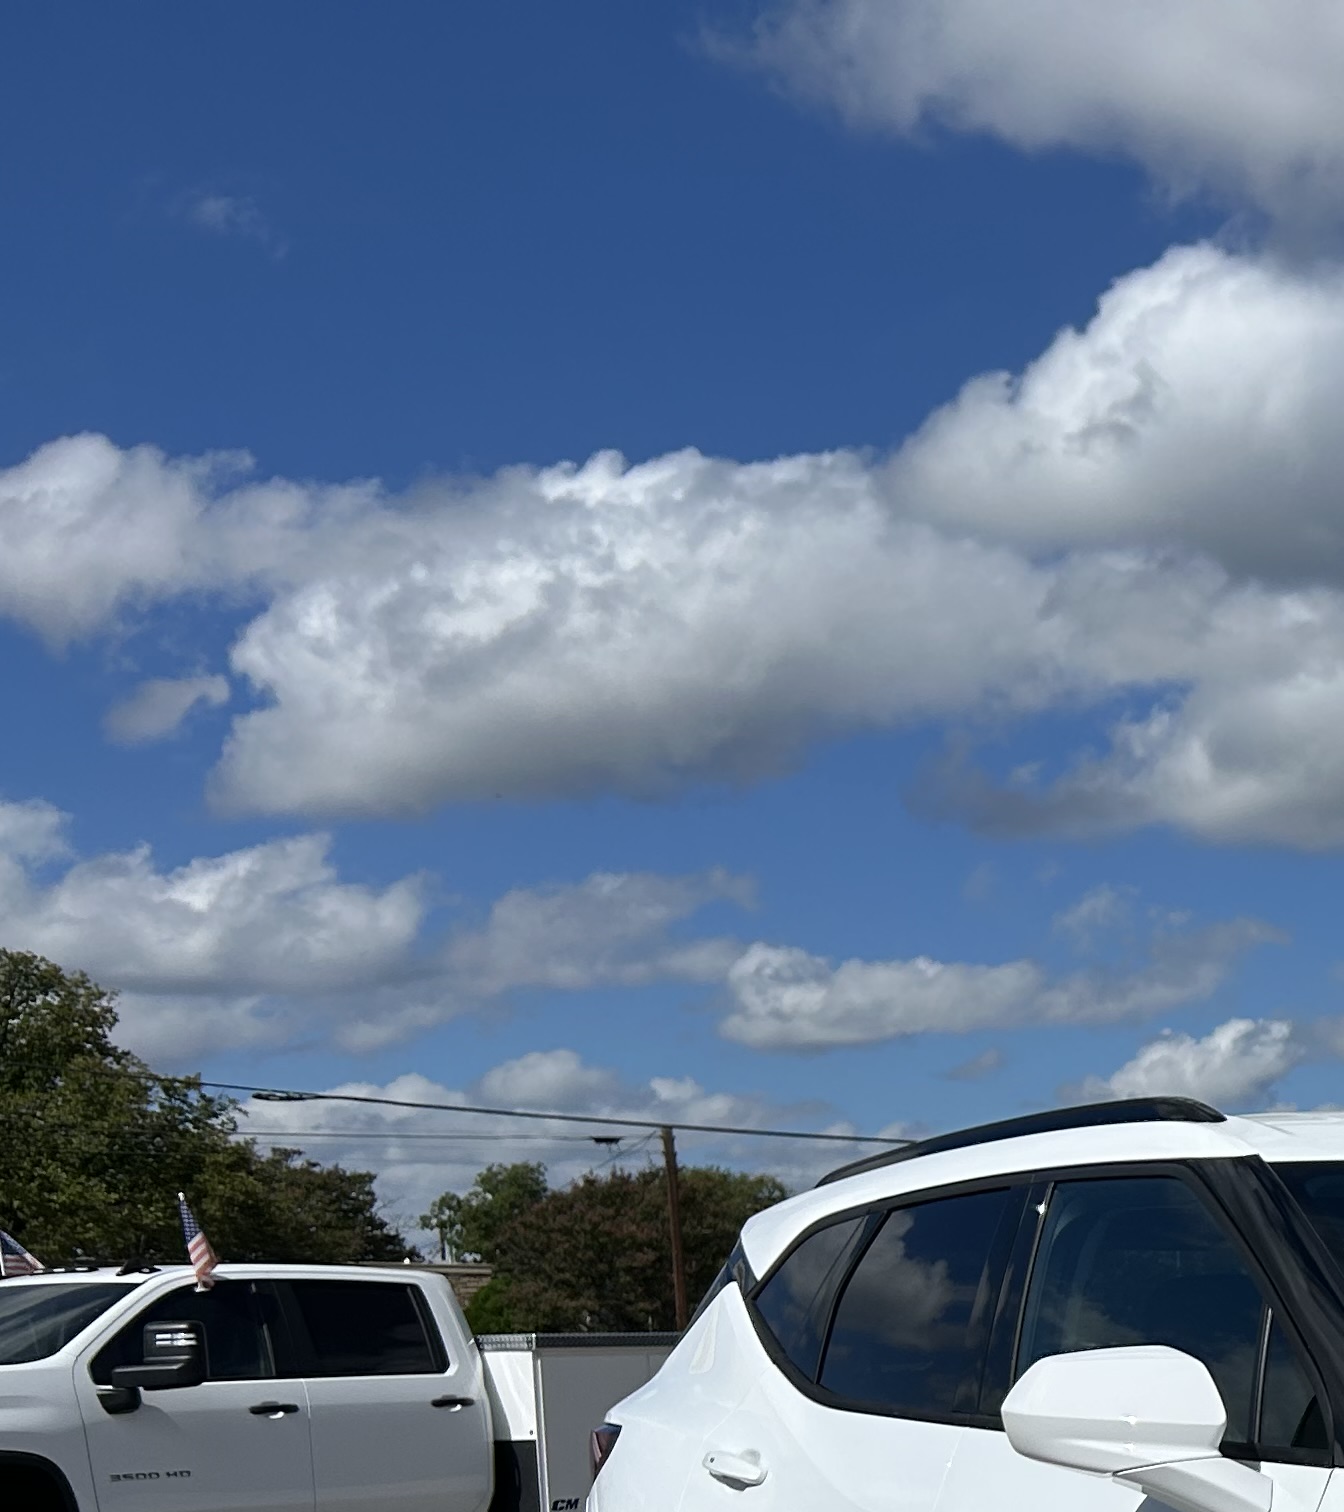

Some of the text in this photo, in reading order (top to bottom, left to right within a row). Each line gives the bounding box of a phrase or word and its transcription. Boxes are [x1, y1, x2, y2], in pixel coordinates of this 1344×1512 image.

[110, 1470, 191, 1482] 3500 HD
[552, 1498, 580, 1511] CM
